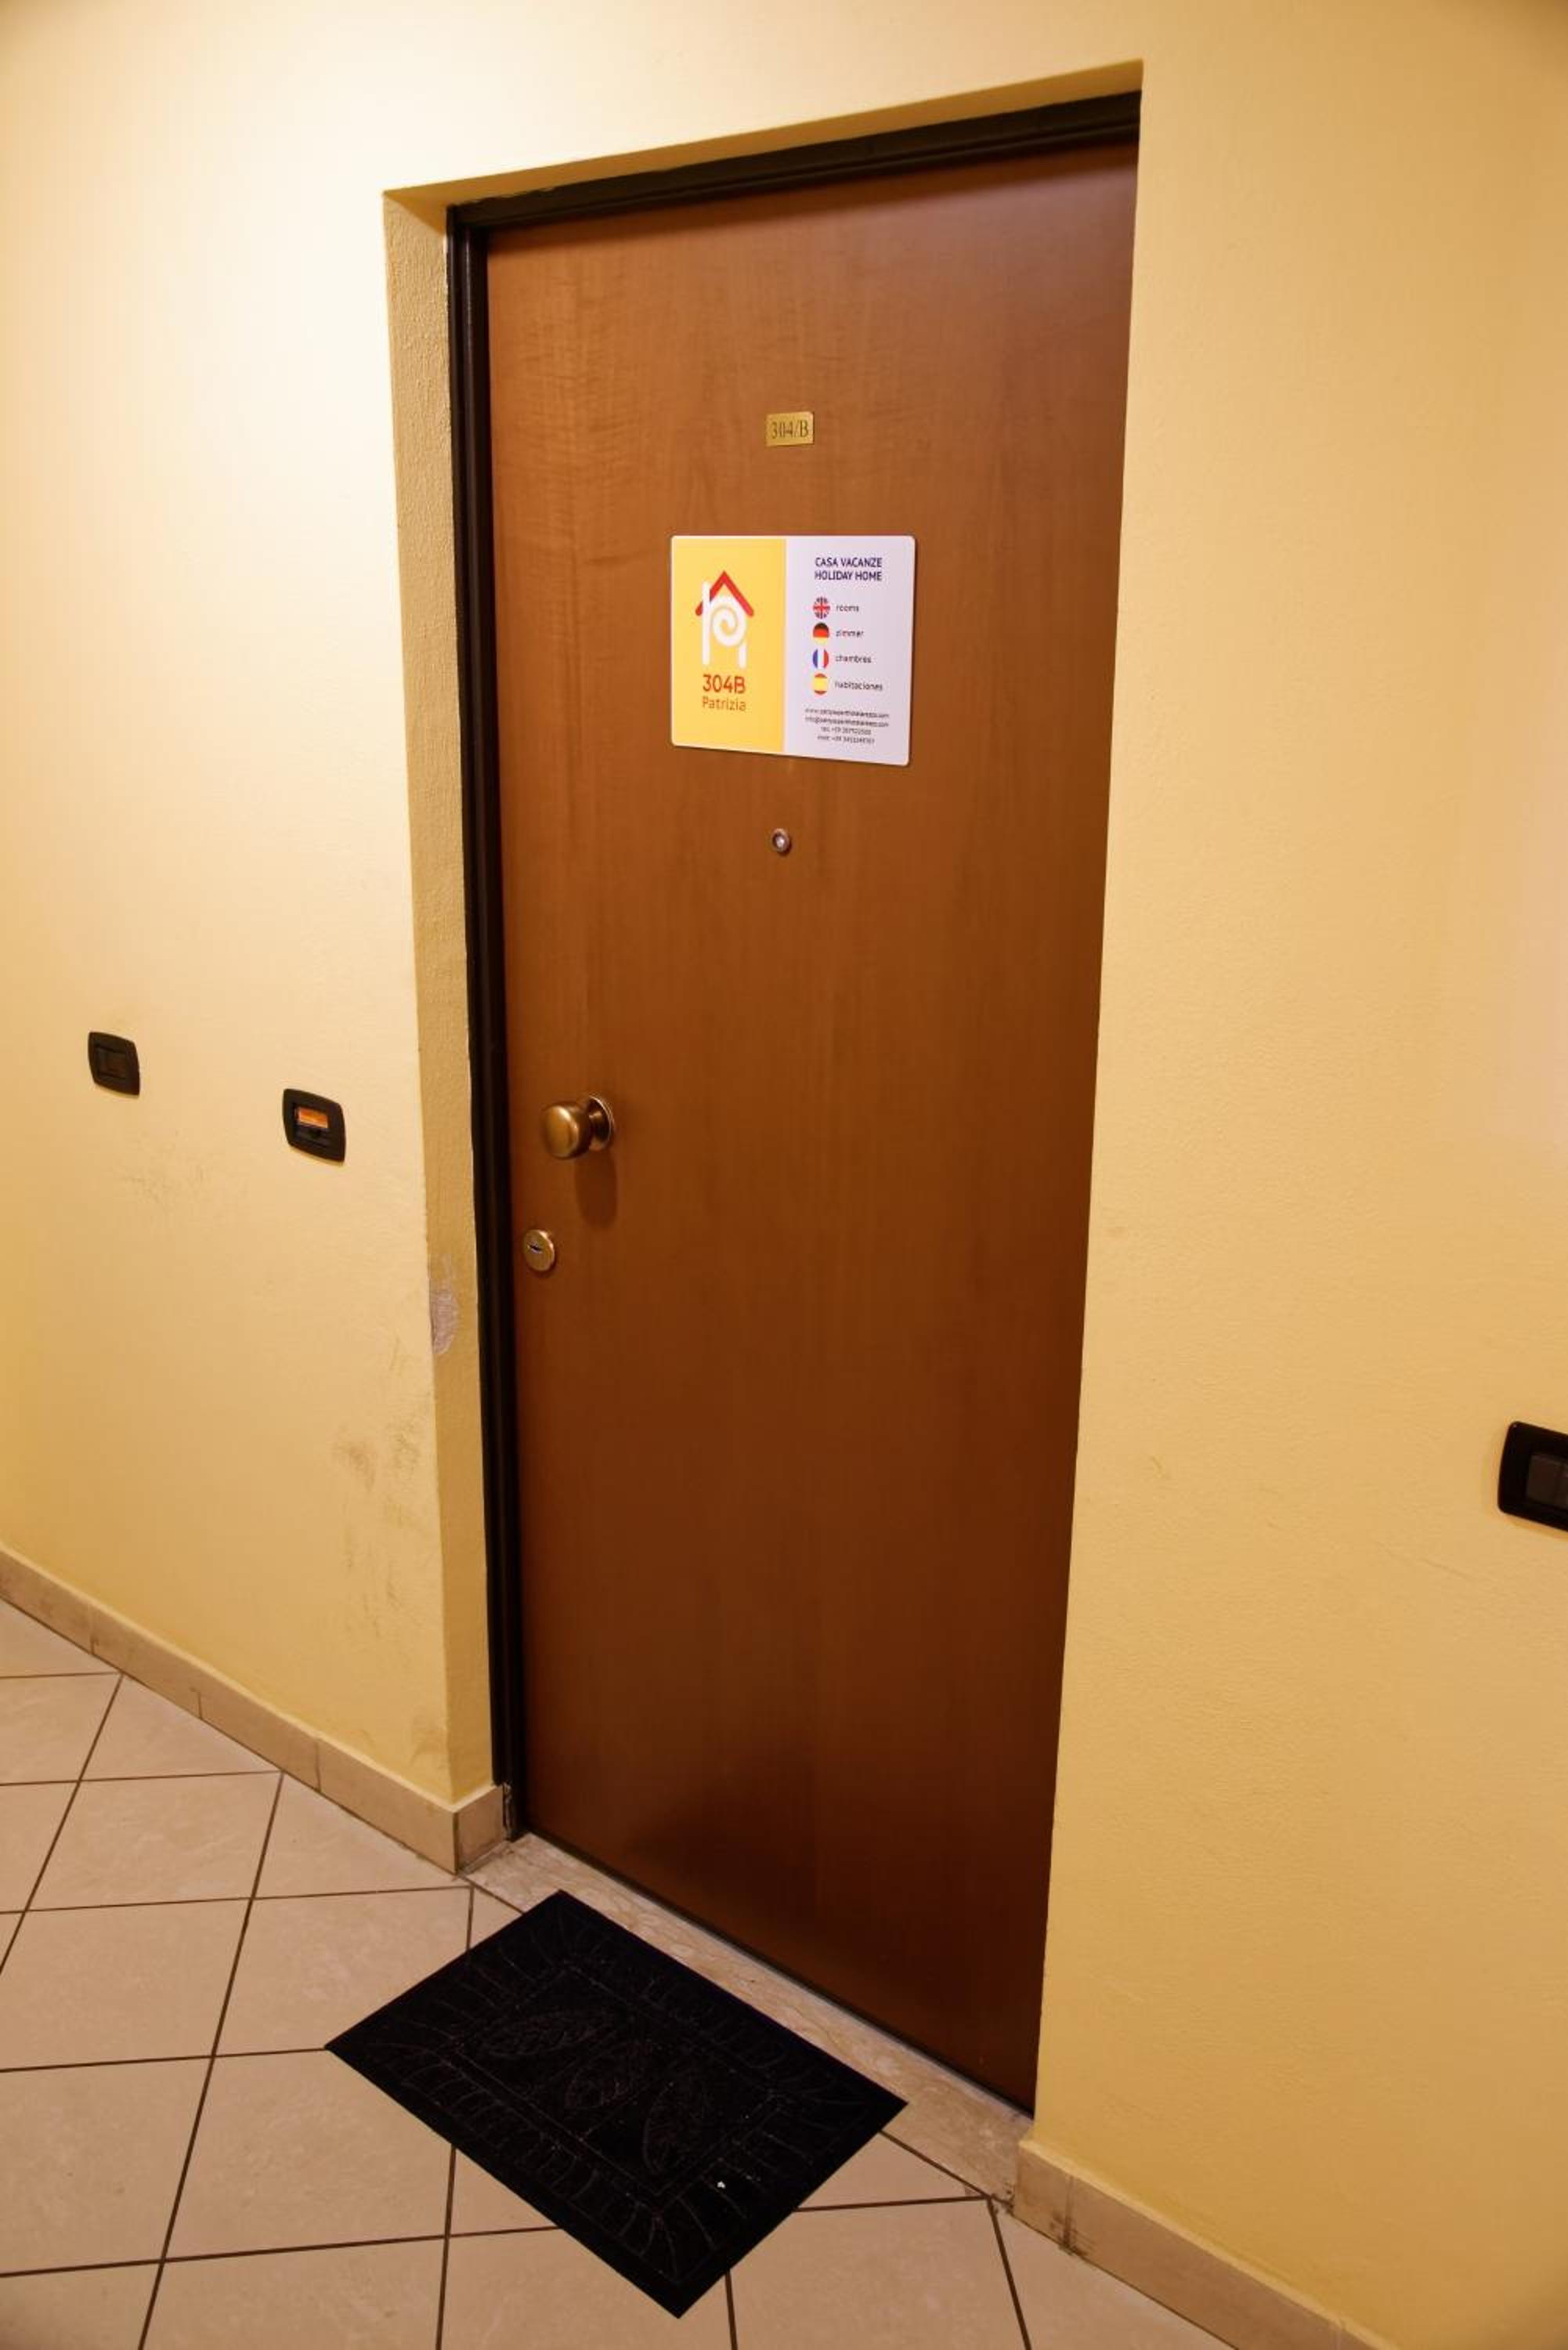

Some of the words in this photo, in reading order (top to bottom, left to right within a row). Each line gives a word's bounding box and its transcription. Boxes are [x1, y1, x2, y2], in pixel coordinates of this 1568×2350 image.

[770, 419, 809, 439] 304/B
[815, 556, 838, 568] CASA
[840, 556, 883, 568] VACANZE
[815, 569, 853, 581] HOLIDAY
[854, 570, 883, 582] HOME
[836, 604, 860, 613] rooms
[835, 654, 873, 664] chambres
[703, 674, 746, 694] 304B
[834, 680, 883, 692] habitaciones
[702, 695, 746, 712] Patrizia
